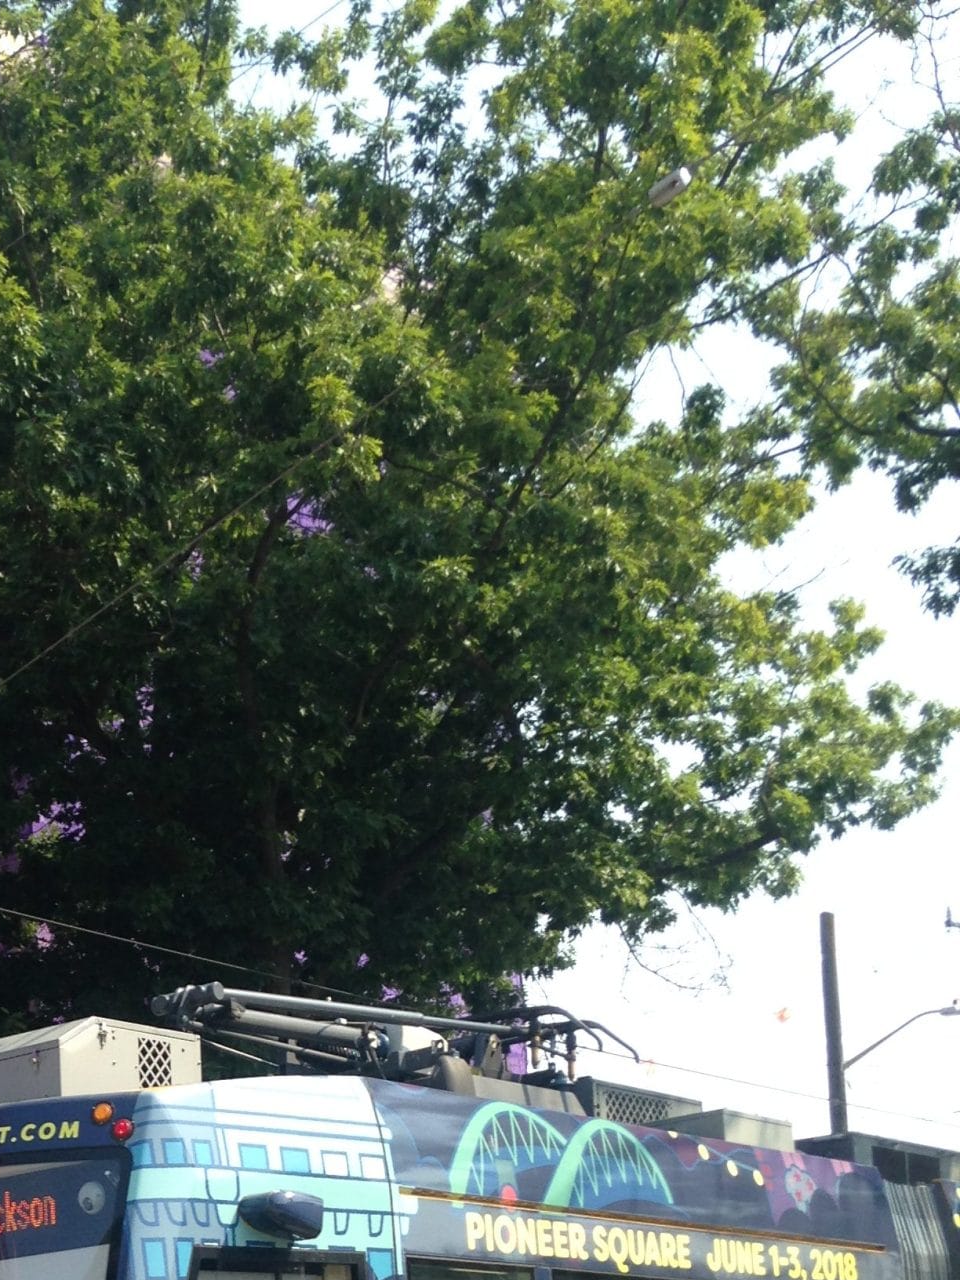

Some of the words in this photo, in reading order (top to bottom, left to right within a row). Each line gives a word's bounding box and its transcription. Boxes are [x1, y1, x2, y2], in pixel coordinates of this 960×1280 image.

[465, 1212, 589, 1260] PIONEER
[592, 1225, 692, 1273] SQUARE
[706, 1238, 766, 1276] JUNE
